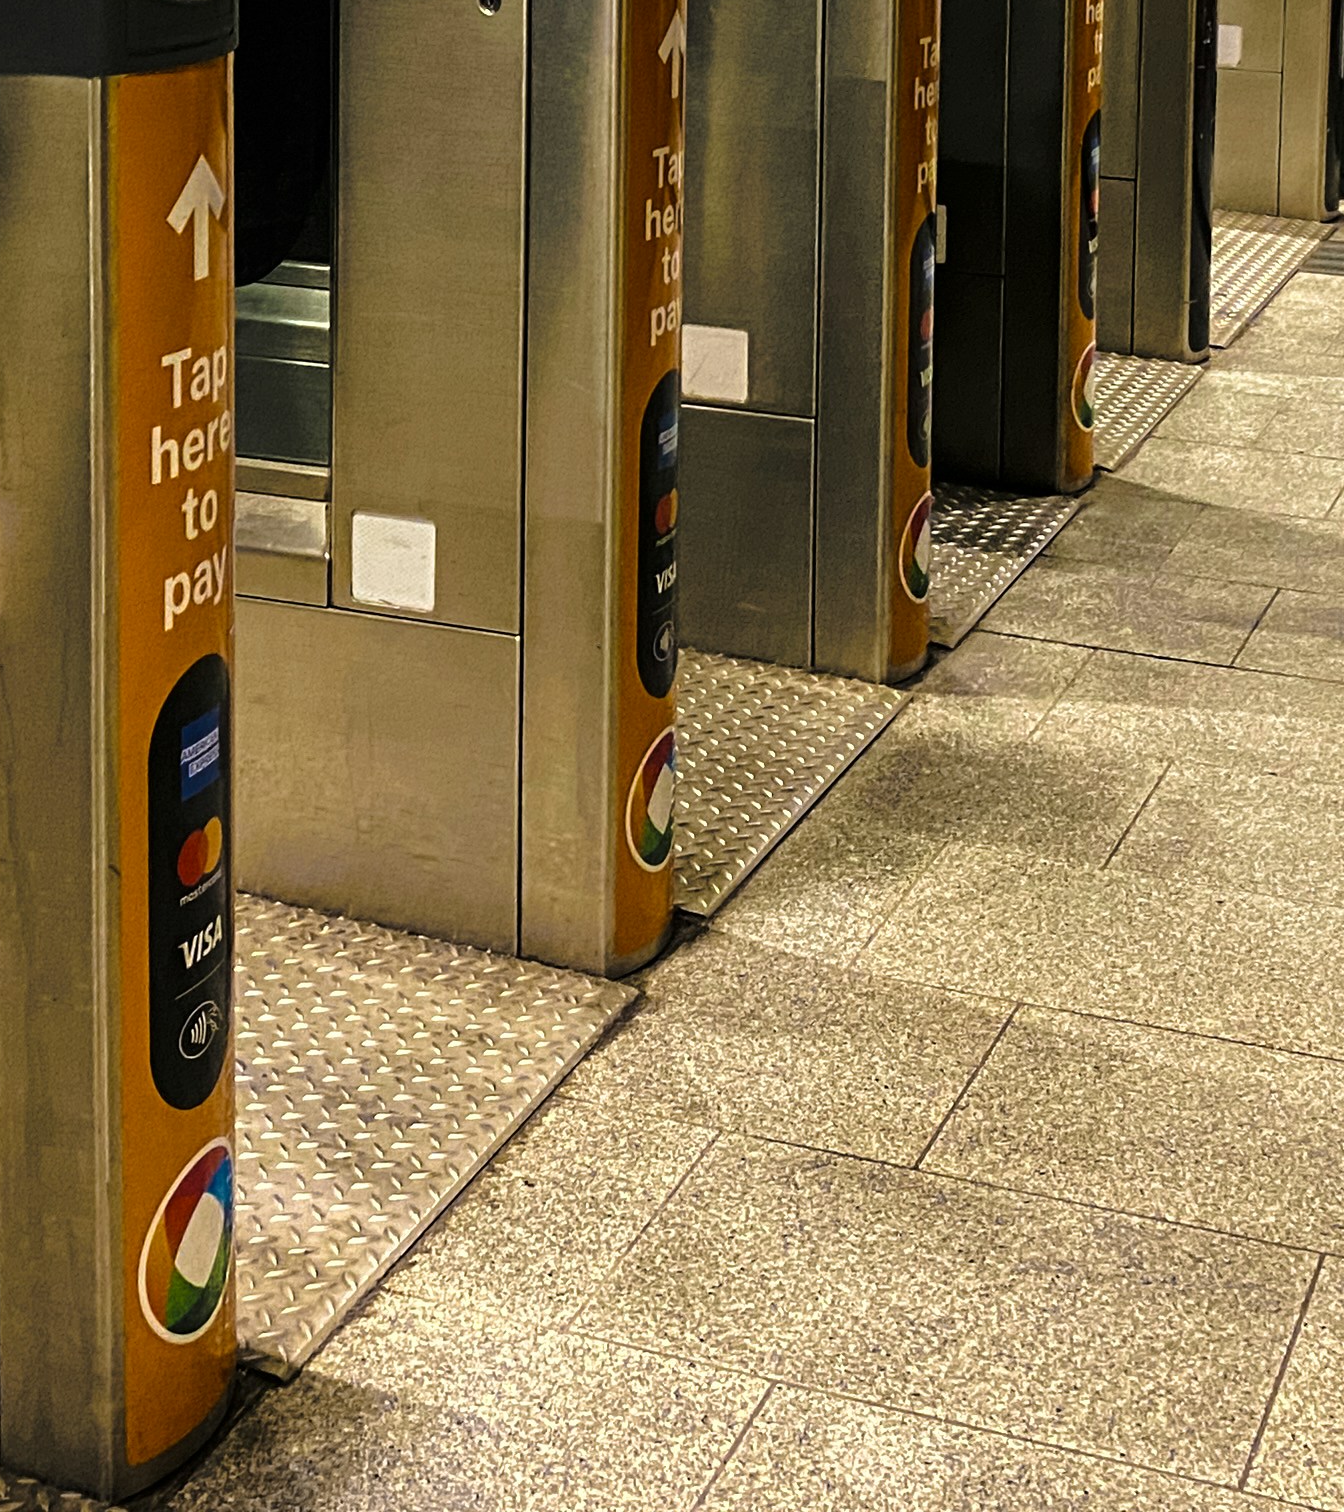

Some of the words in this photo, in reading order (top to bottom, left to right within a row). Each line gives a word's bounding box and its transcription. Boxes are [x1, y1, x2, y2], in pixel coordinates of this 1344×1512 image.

[920, 36, 940, 69] Ta
[914, 76, 939, 110] he
[917, 157, 936, 194] pa
[645, 199, 683, 241] her
[161, 345, 227, 409] Tap
[151, 409, 232, 485] here
[181, 488, 219, 540] to
[164, 544, 227, 632] pay
[178, 914, 222, 969] VISA
